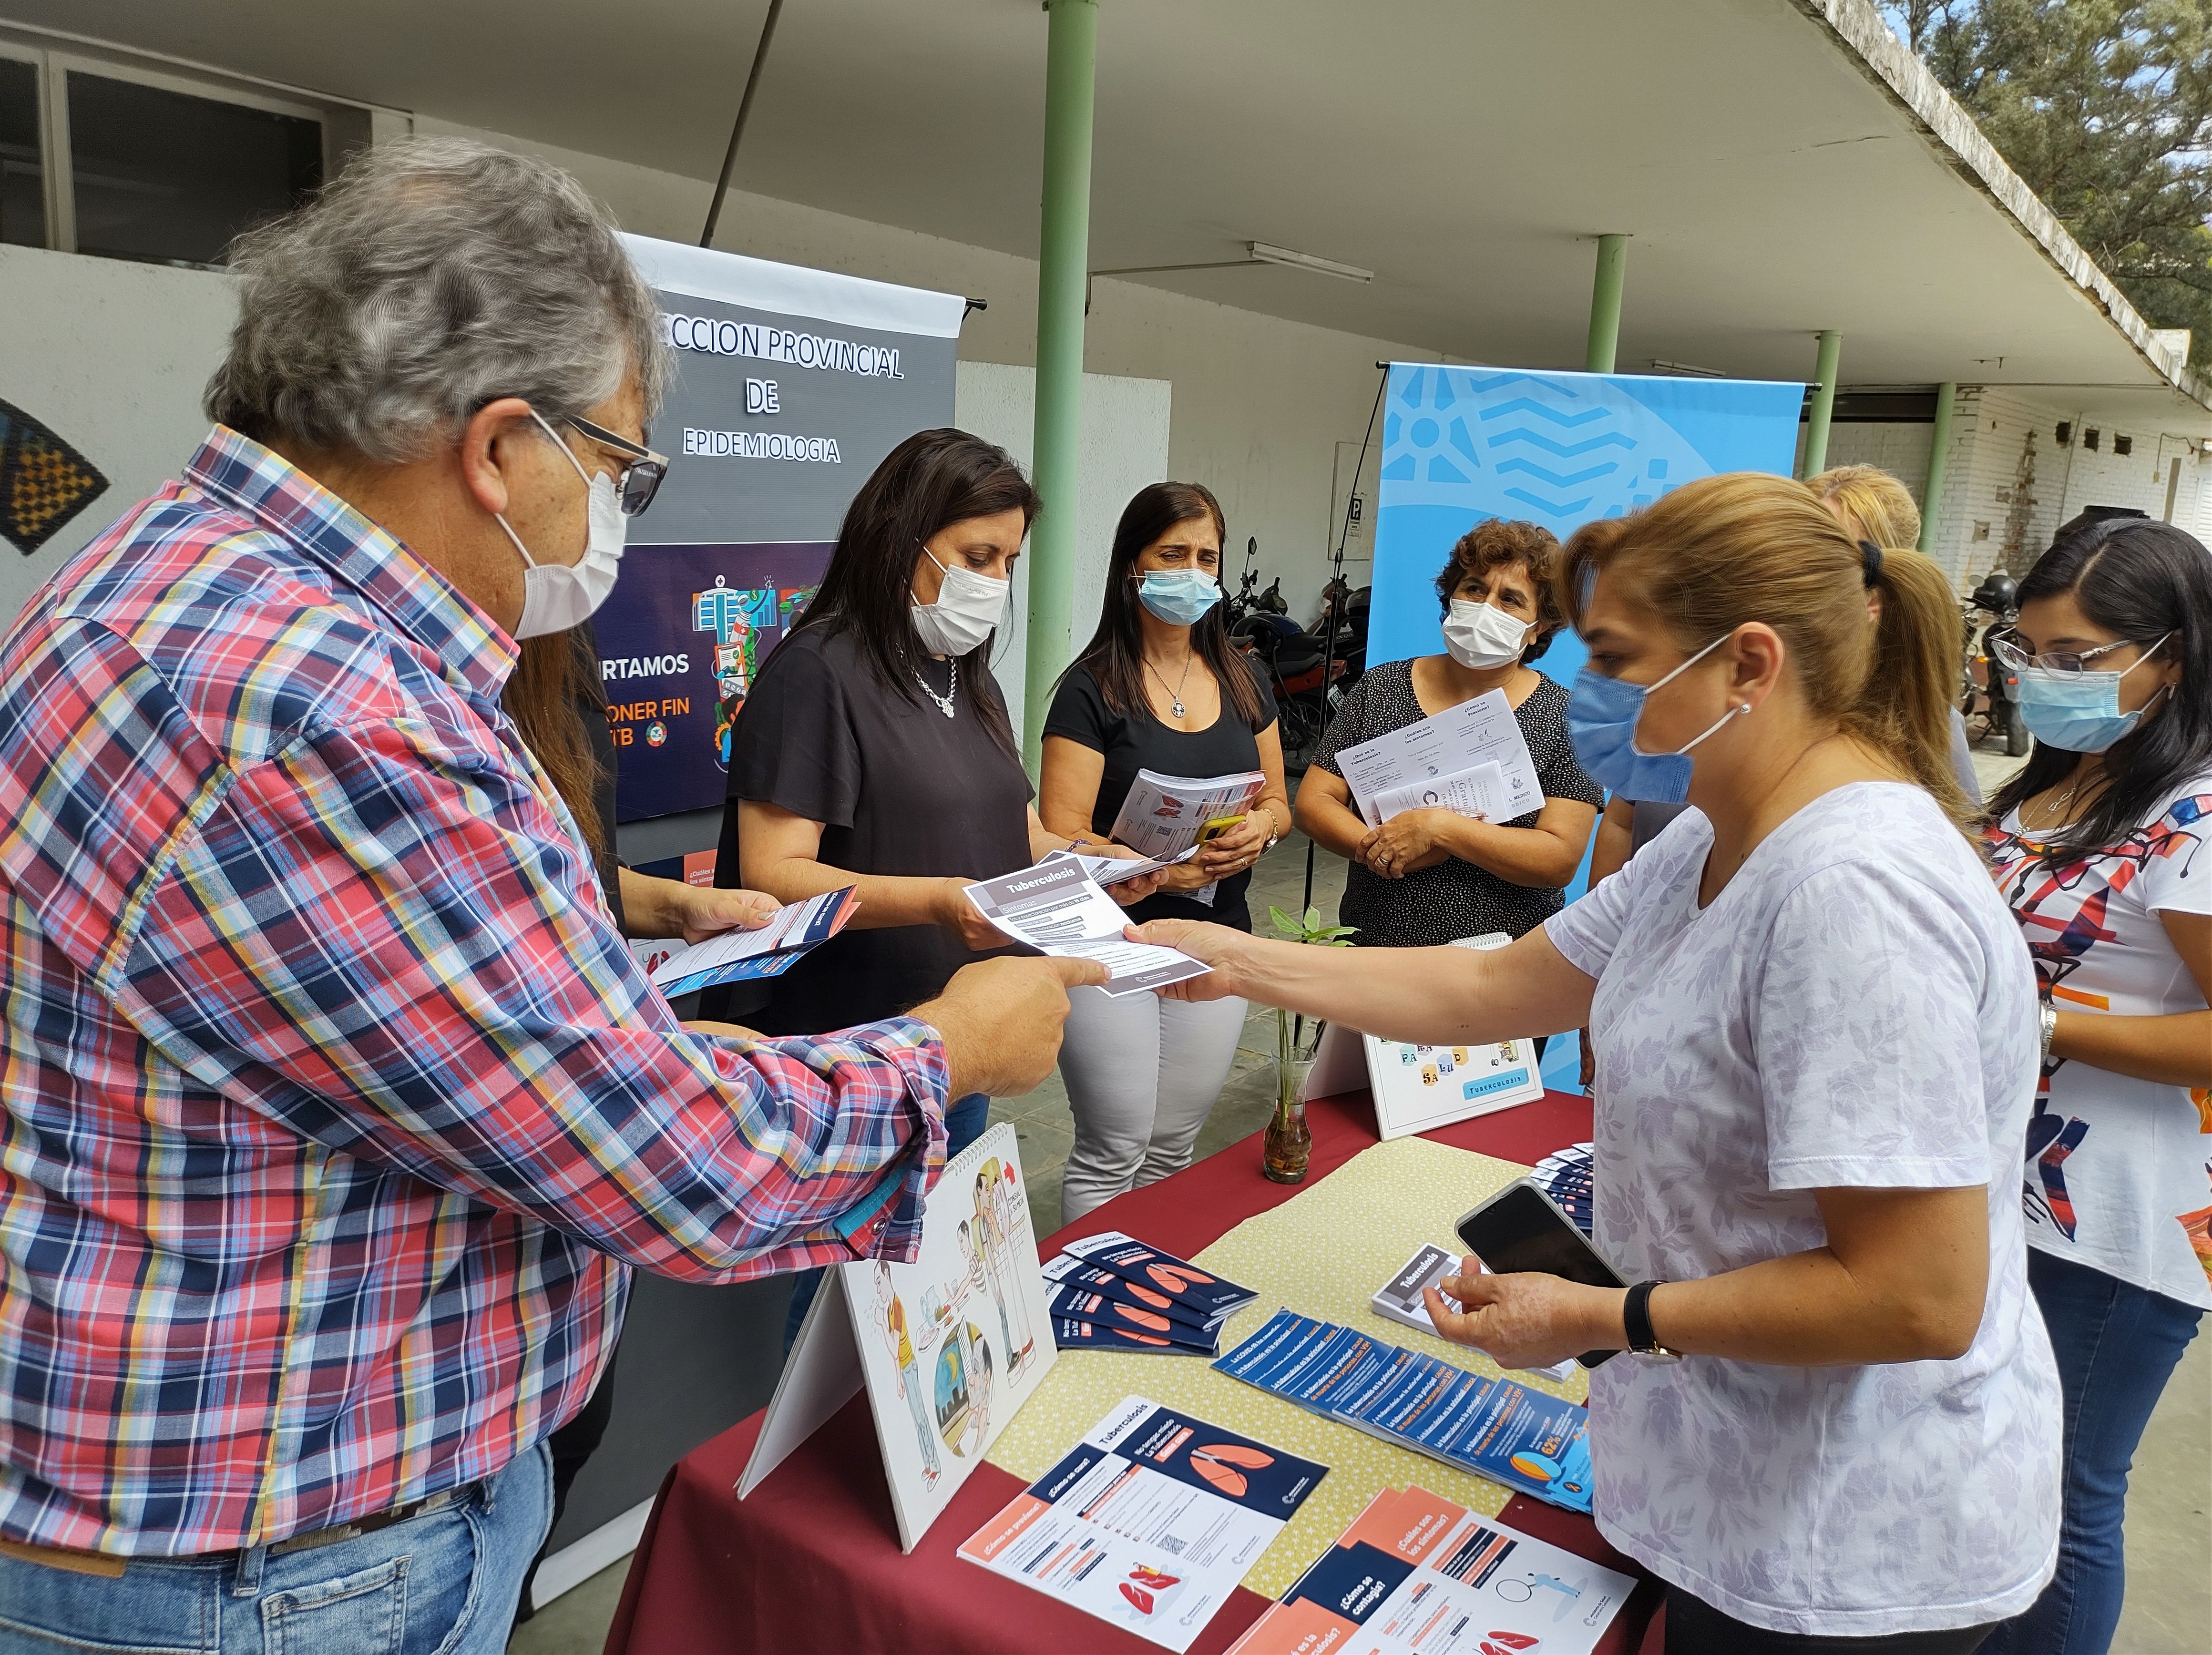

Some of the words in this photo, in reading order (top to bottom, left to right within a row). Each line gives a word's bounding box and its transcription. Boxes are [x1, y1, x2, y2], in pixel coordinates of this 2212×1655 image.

[768, 329, 902, 378] PROVINCIAL
[748, 382, 778, 411] DE
[685, 430, 840, 462] EPIDEMIOLOGIA
[605, 701, 658, 723] ONER
[662, 697, 690, 716] FIN
[1468, 705, 1490, 717] Previene?
[609, 727, 634, 747] TB
[1350, 751, 1381, 766] Tuberculosis?
[1511, 798, 1530, 808] ODICO
[1513, 790, 1531, 801] MEDICO
[1006, 867, 1076, 894] Tuberculosis
[1003, 900, 1037, 914] Síntomas
[1469, 1075, 1522, 1095] TUBERCULOSIS
[1074, 1236, 1124, 1251] Tuberculosis
[1399, 1252, 1439, 1288] Tuberculosis
[1237, 1343, 1258, 1359] COVID-19
[1241, 1352, 1266, 1370] tuberculosis
[1306, 1373, 1330, 1393] tuberculosis
[1336, 1349, 1353, 1366] principal
[1351, 1338, 1363, 1350] causa
[1316, 1384, 1331, 1396] muerte
[1339, 1358, 1357, 1374] personas
[1355, 1349, 1363, 1358] con
[1360, 1341, 1371, 1349] VIH
[1351, 1389, 1374, 1409] tuberculosis
[1381, 1364, 1397, 1382] principal
[1393, 1402, 1415, 1423] tuberculosis
[1421, 1378, 1437, 1395] principal
[1435, 1366, 1446, 1380] causa
[1402, 1413, 1416, 1426] muerte
[1424, 1387, 1441, 1405] personas
[1440, 1379, 1448, 1388] con
[1444, 1369, 1454, 1379] VIH
[1099, 1403, 1148, 1446] Tuberculosis
[1440, 1421, 1461, 1443] tuberculosis
[1466, 1395, 1481, 1414] principal
[1468, 1425, 1488, 1447] tuberculosis
[1491, 1397, 1505, 1417] principal
[1504, 1385, 1514, 1398] causa
[1478, 1437, 1491, 1451] muerte
[1498, 1407, 1512, 1427] personas
[1513, 1388, 1523, 1400] VIH
[1134, 1447, 1144, 1455] No
[1151, 1424, 1181, 1450] Tuberculosis
[1541, 1433, 1560, 1454] 62%
[1066, 1471, 1076, 1480] se
[1074, 1458, 1090, 1472] cura?
[1397, 1526, 1422, 1551] ¿Cuáles
[1419, 1514, 1433, 1527] son
[1406, 1545, 1421, 1556] los
[1418, 1514, 1448, 1545] síntomas?
[1340, 1584, 1364, 1609] ¿Cómo
[1362, 1576, 1372, 1586] se
[1352, 1581, 1384, 1614] contagia?
[1298, 1642, 1309, 1652] es
[1304, 1634, 1317, 1643] la
